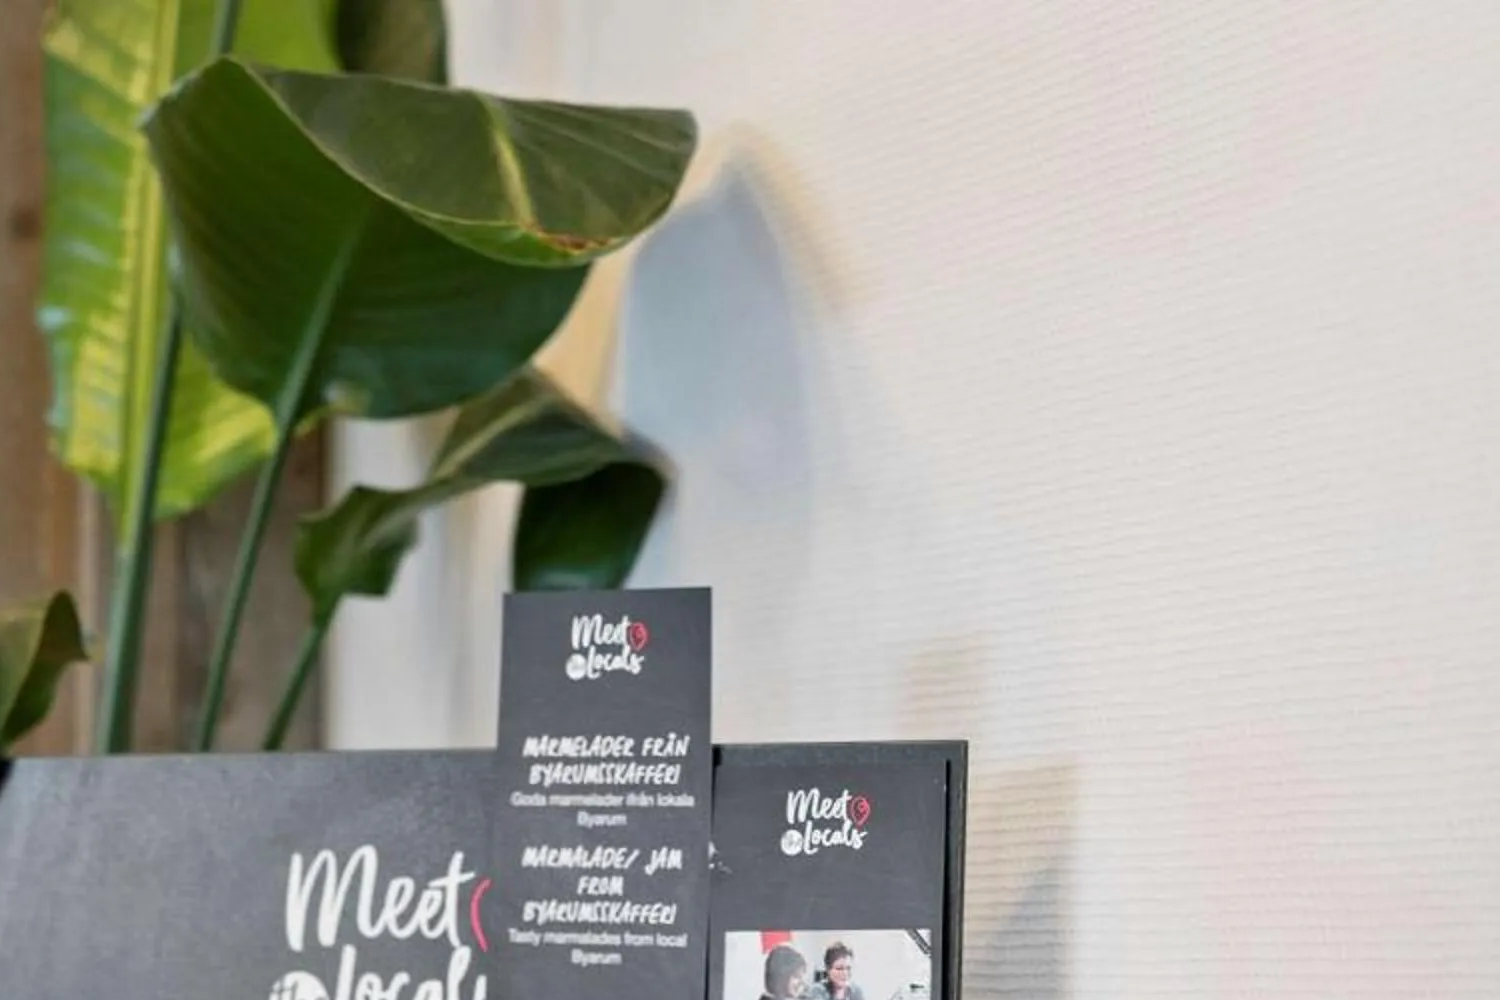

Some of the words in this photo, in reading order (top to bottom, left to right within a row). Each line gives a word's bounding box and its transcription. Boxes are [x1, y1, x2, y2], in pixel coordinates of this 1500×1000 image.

[522, 735, 635, 758] MARMELADER
[641, 732, 690, 757] FRÅN
[577, 810, 627, 828] Byarum
[786, 787, 852, 825] Meet
[803, 819, 868, 855] Locals
[644, 846, 683, 875] JAM
[285, 844, 476, 952] Meet
[577, 875, 624, 896] FROM
[508, 928, 541, 946] Tasty
[623, 930, 654, 946] from
[656, 932, 688, 947] local
[571, 948, 622, 967] Byarum
